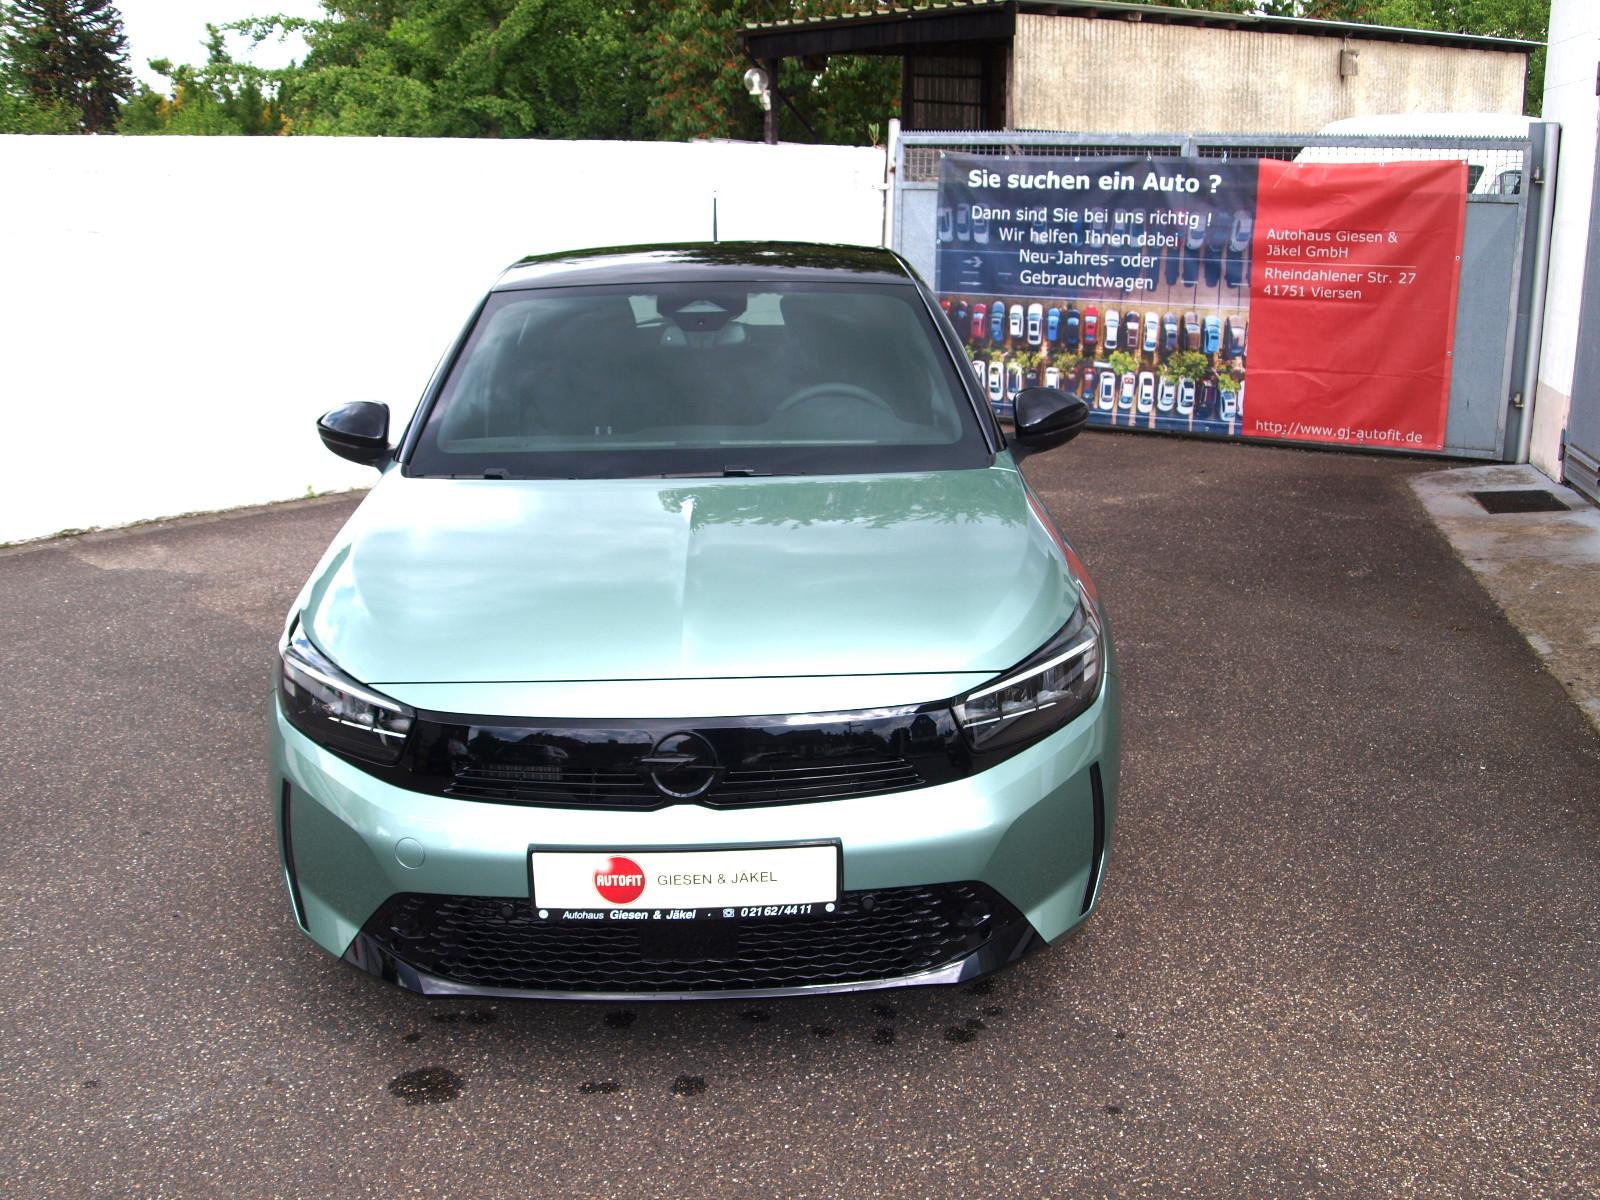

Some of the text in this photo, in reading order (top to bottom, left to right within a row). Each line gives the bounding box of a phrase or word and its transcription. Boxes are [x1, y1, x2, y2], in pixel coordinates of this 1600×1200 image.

[968, 169, 1222, 194] Sie suchen ein Auto ?
[971, 205, 1011, 221] Dann
[1016, 206, 1047, 222] sind
[1053, 207, 1078, 223] Sie
[1084, 208, 1109, 224] bei
[1114, 211, 1144, 224] uns
[1149, 210, 1200, 229] richtig
[999, 227, 1179, 247] Wir helfen Ihnen dabei
[1266, 228, 1398, 243] Autohaus Giesen &
[1019, 249, 1157, 268] Neu-Jahres- oder
[1266, 244, 1348, 258] Jäkel GmbH
[1020, 269, 1154, 292] Gebrauchtwagen
[1264, 268, 1417, 284] Rheindahlener Str. 27
[1263, 285, 1362, 299] 41751 Viersen
[1256, 420, 1423, 443] http://www.gj-autofit.de
[596, 874, 643, 887] AUTOFIT
[657, 874, 712, 886] GIESEN
[717, 873, 727, 885] &
[562, 910, 604, 920] Autohaus
[609, 910, 649, 920] Giesen
[653, 910, 661, 920] &
[666, 909, 696, 920] Jäkel
